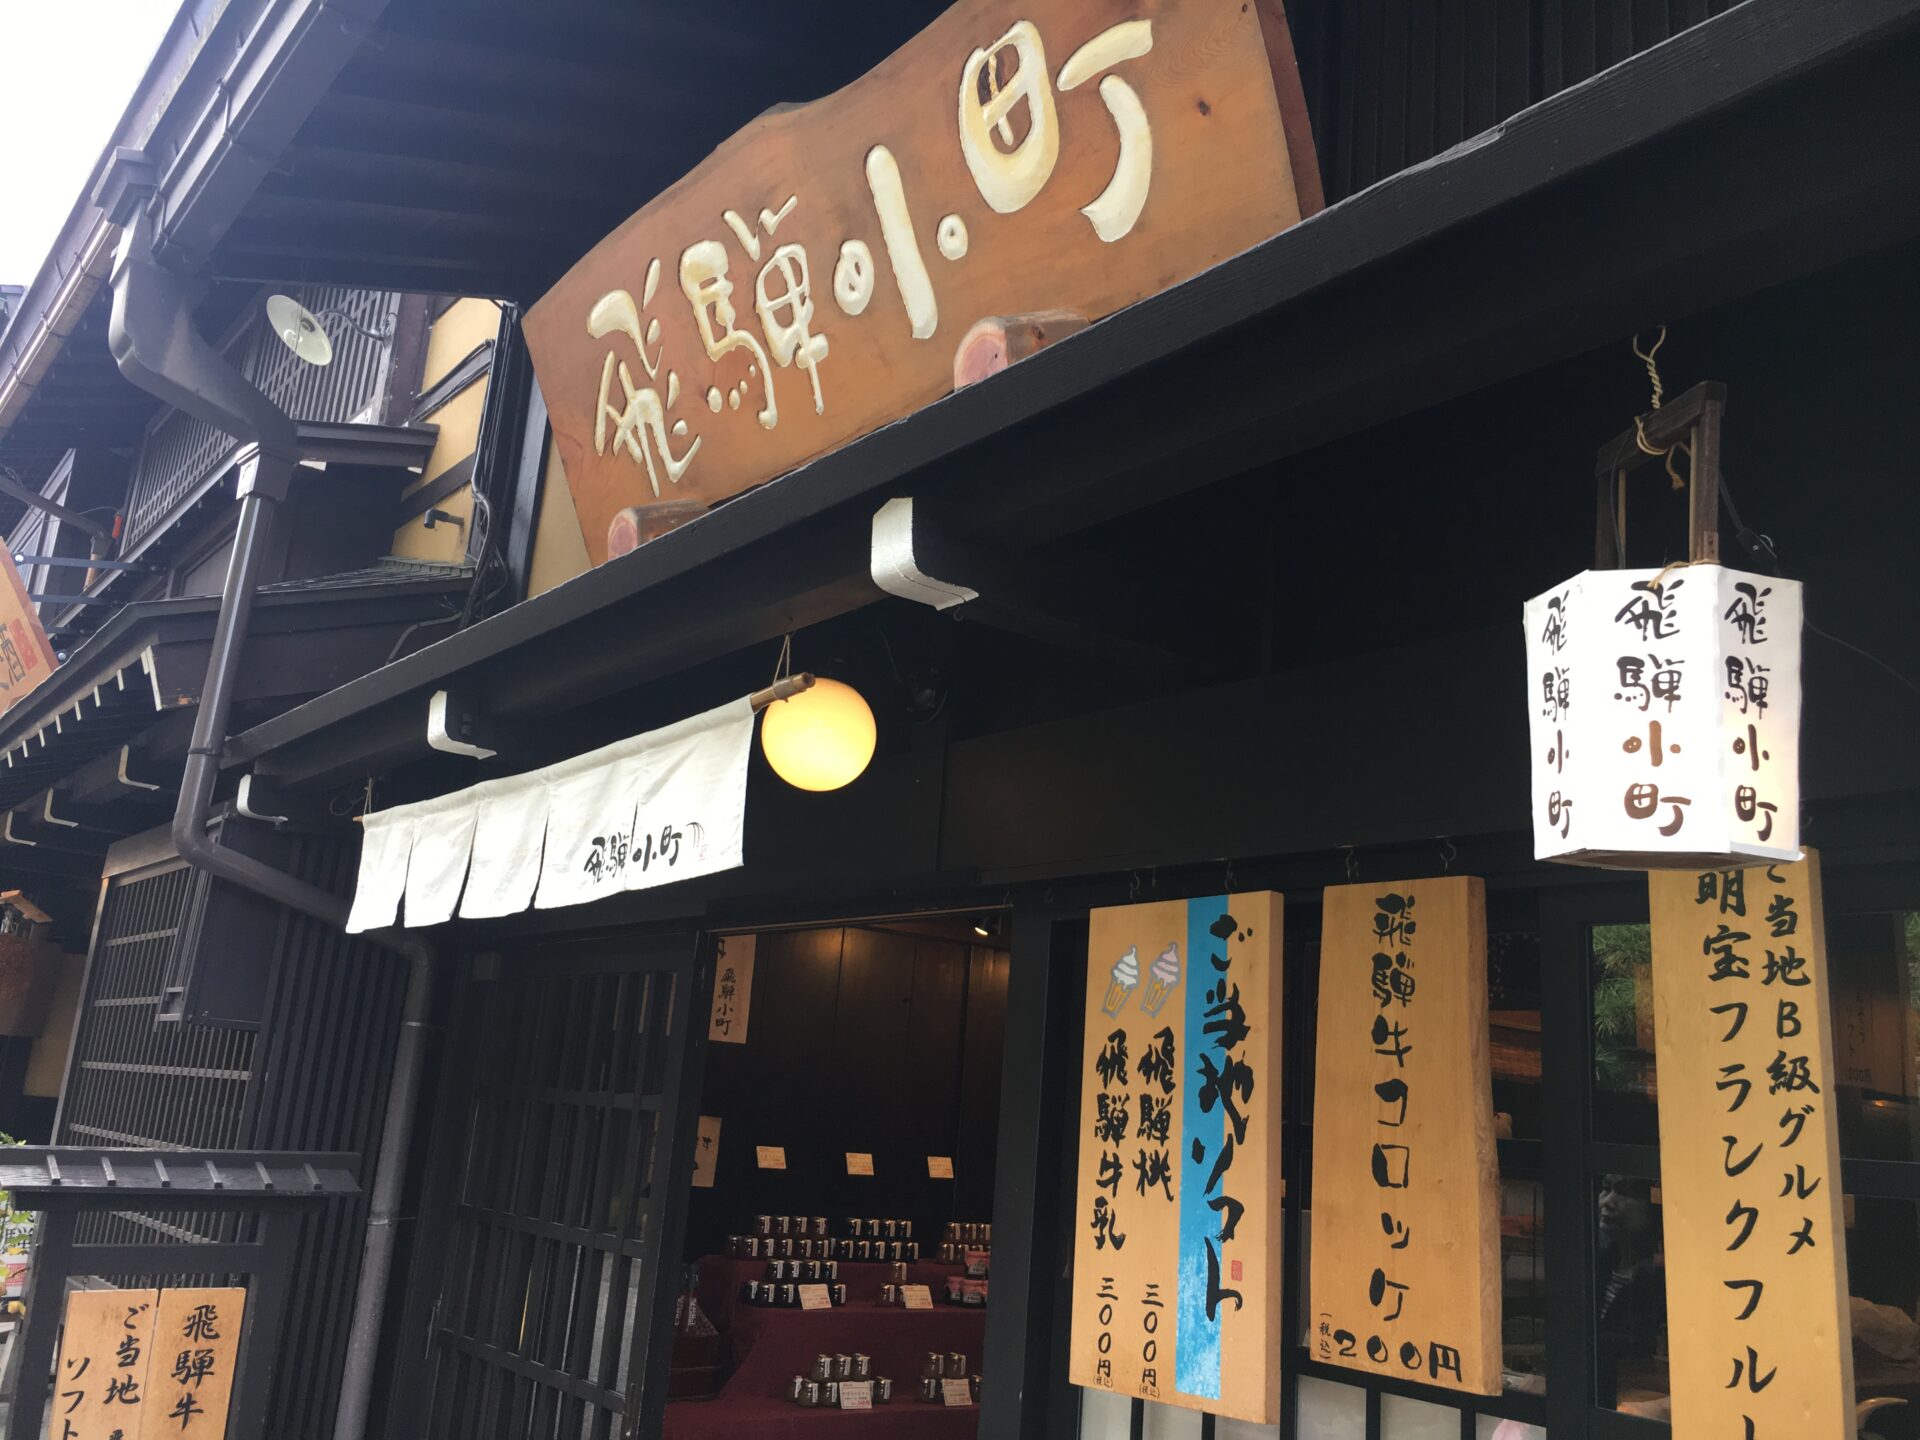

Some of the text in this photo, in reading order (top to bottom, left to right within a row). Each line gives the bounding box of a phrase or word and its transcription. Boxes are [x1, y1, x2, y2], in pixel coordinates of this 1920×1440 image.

[586, 18, 1154, 498] 飛騨小町
[1542, 589, 1573, 839] 飛騨小町
[1614, 579, 1692, 837] 飛騨小町
[1724, 582, 1778, 841] 飛騨小町
[583, 824, 683, 885] 飛騨小町
[715, 967, 737, 1036] 飛騨小町
[1132, 1025, 1176, 1203] 飛騨桃
[1191, 914, 1255, 1322] ご当地ソフト
[1369, 892, 1417, 1322] 飛騨牛コロッケ
[1090, 1027, 1131, 1251] 飛騨牛乳
[168, 1304, 221, 1432] 飛騨牛
[1333, 1328, 1462, 1383] 200円
